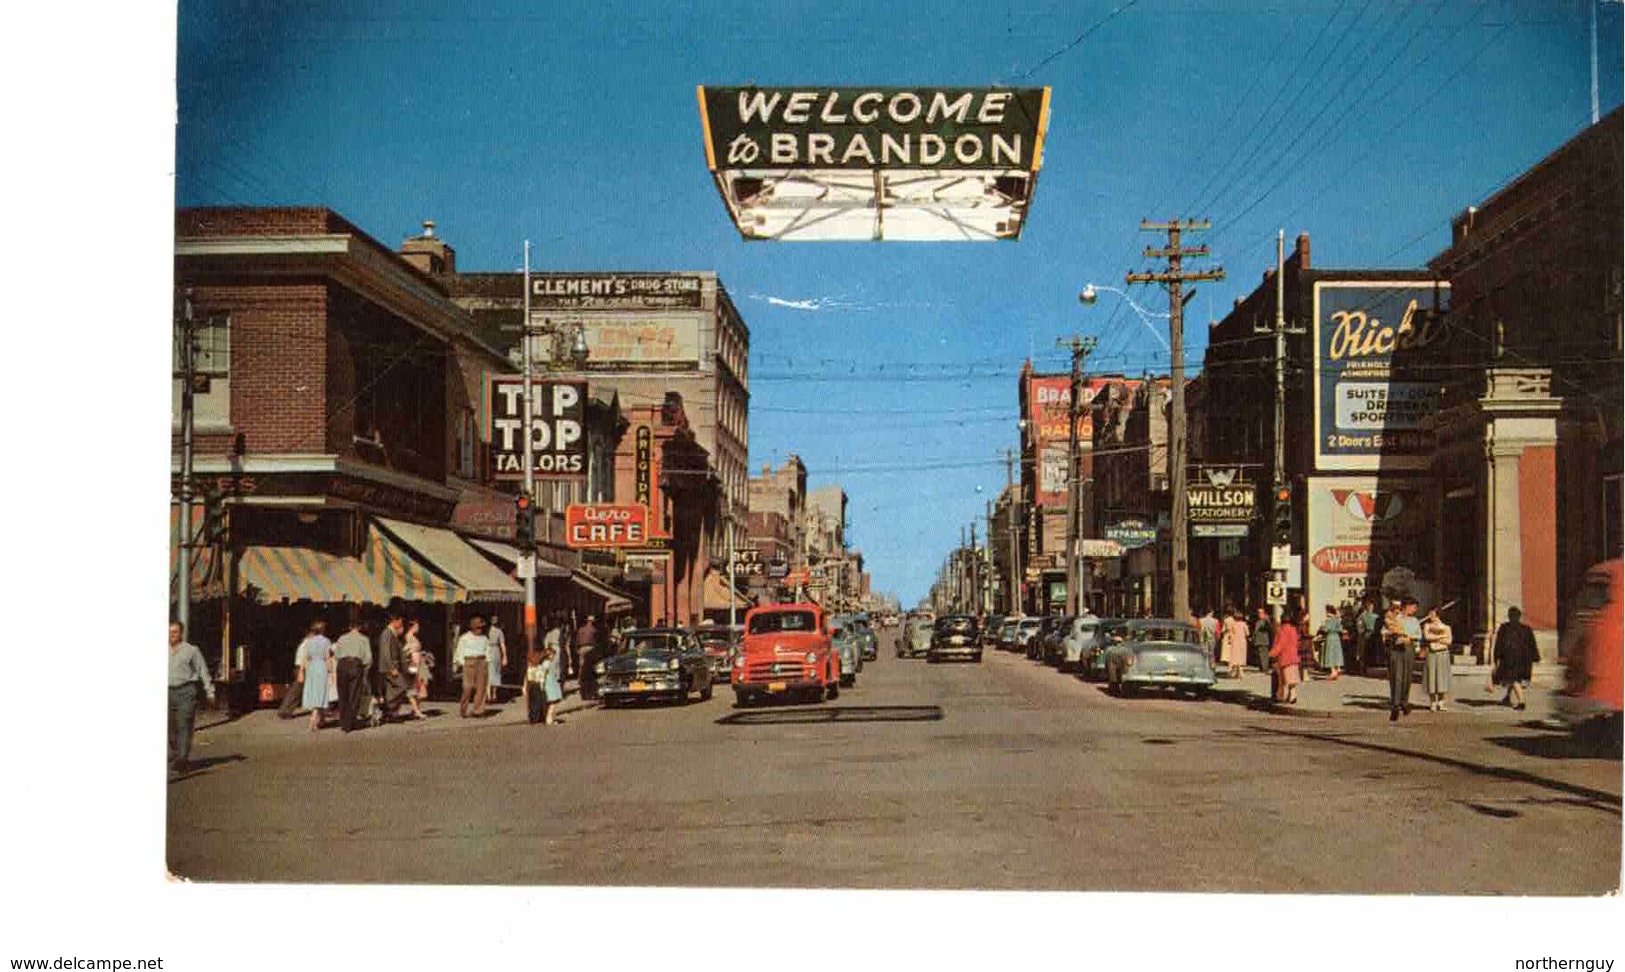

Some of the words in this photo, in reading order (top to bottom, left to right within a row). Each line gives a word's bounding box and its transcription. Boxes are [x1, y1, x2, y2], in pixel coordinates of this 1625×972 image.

[738, 91, 1012, 124] WELCOME
[727, 133, 759, 163] to
[770, 133, 1021, 164] BRANDON
[533, 276, 627, 295] CLEMENT'S
[1340, 370, 1390, 378] ATMOSPHER
[498, 384, 579, 416] TIP
[1347, 389, 1386, 399] SUITS
[494, 419, 582, 451] TOP
[1328, 436, 1337, 447] 2
[1338, 435, 1372, 447] Doors
[638, 428, 648, 505] FRIGIDA
[1187, 491, 1254, 506] WILLSON
[585, 508, 630, 521] Aero
[1190, 508, 1252, 518] STATIONERY
[573, 524, 642, 542] CAFE
[726, 563, 763, 575] CAFE
